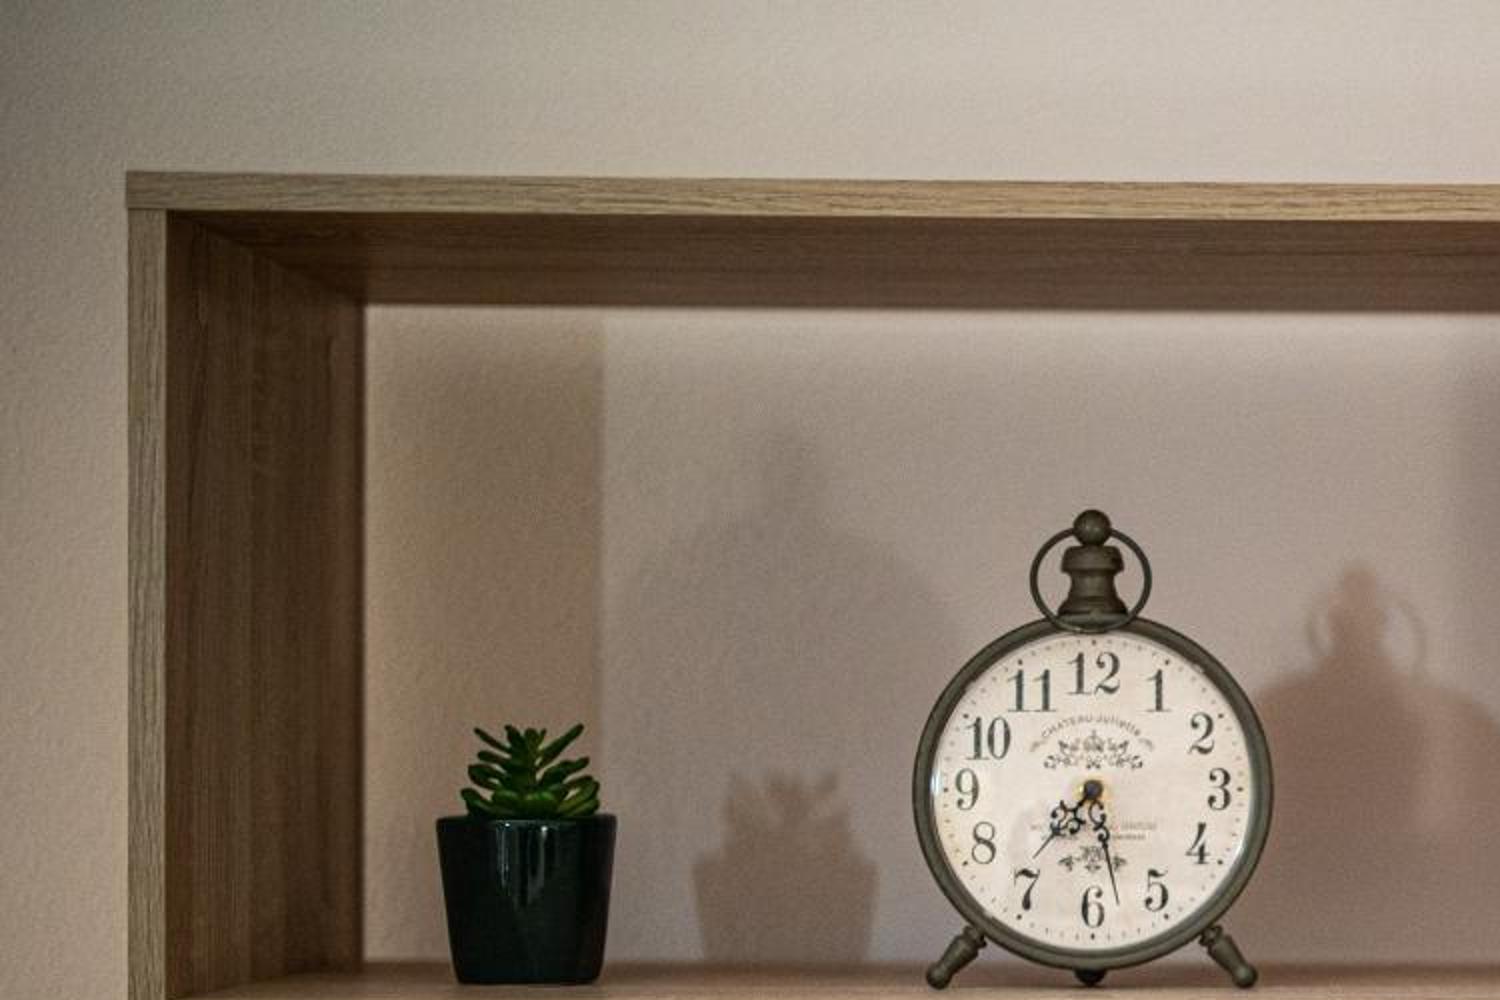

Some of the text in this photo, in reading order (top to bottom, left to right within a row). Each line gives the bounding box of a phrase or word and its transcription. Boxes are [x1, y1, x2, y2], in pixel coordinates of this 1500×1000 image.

[1007, 668, 1057, 713] 11
[1067, 651, 1120, 695] 12
[1146, 669, 1170, 713] 1
[964, 716, 1012, 760] 10
[1187, 712, 1215, 756] 2
[954, 768, 980, 811] 9
[1207, 767, 1232, 811] 3
[971, 821, 997, 865] 8
[1185, 821, 1210, 866] 4
[1014, 868, 1041, 912] 7
[1080, 886, 1105, 929] 6
[1144, 868, 1169, 912] 5
